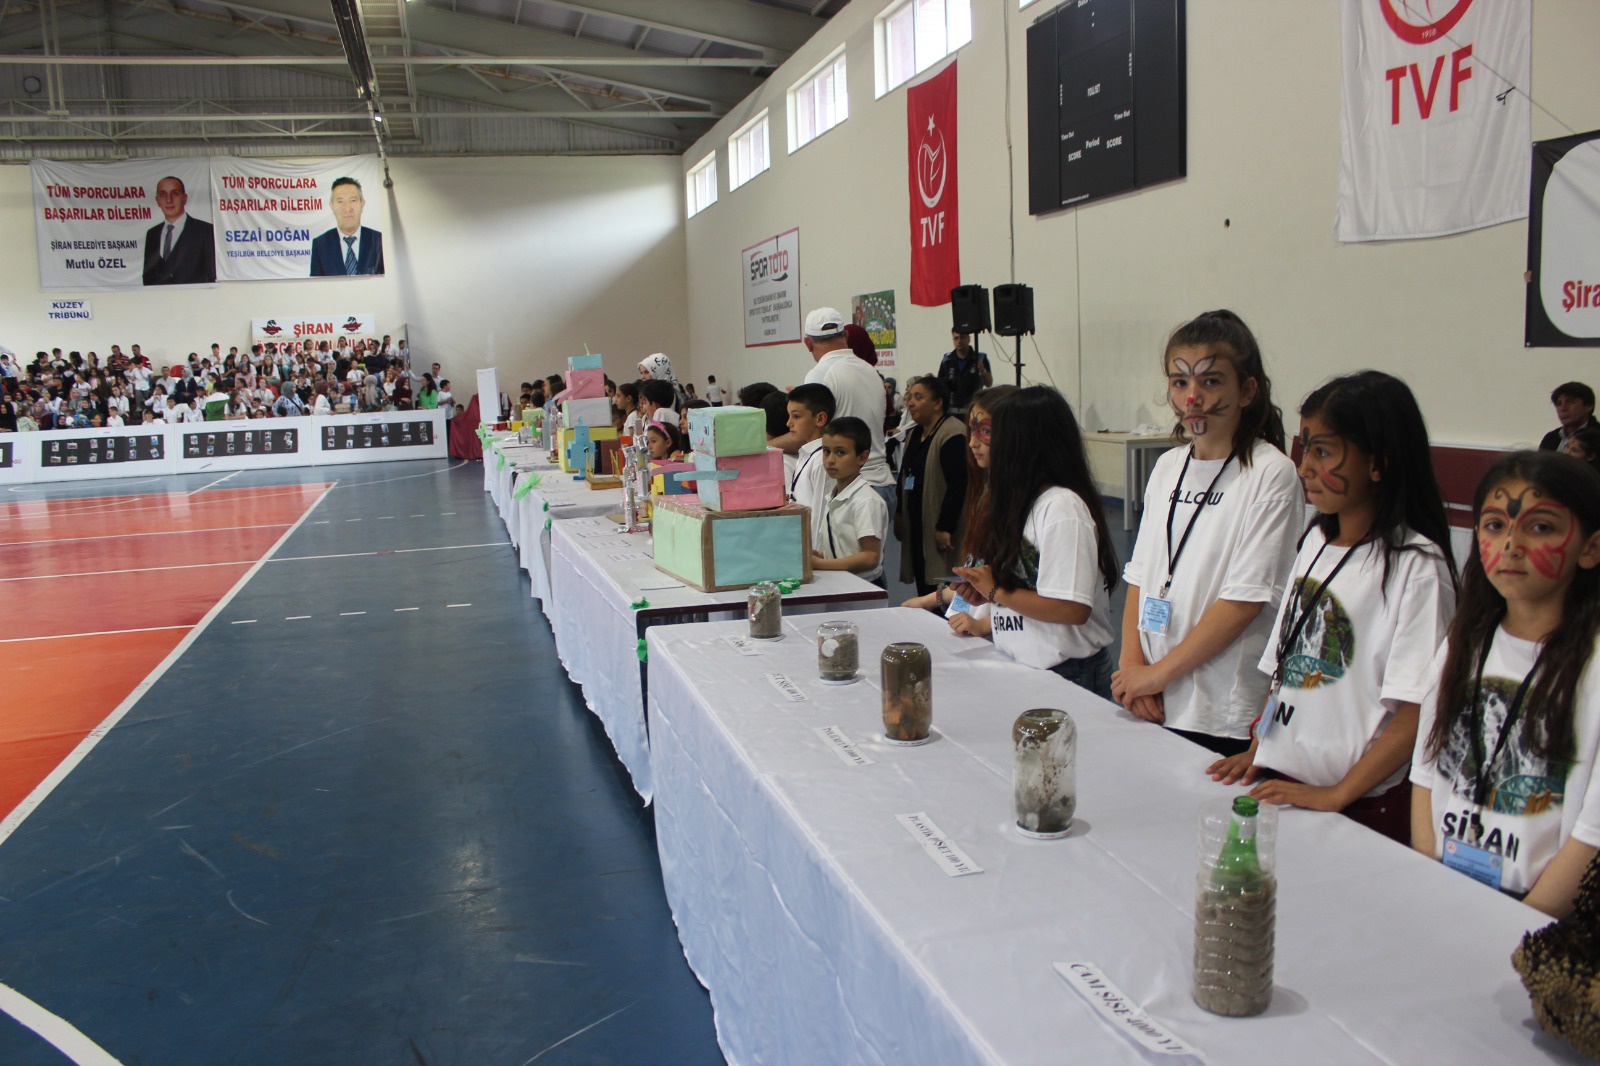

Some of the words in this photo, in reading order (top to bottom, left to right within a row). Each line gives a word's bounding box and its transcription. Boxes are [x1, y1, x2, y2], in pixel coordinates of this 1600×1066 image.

[1385, 43, 1473, 125] TVF
[1086, 136, 1100, 149] Period
[1107, 136, 1122, 149] SCORE
[1068, 150, 1081, 162] SCORE
[222, 174, 245, 189] TÜM
[247, 176, 317, 190] SPORCULARA
[47, 183, 70, 198] TÜM
[73, 186, 146, 200] SPORCULARA
[219, 198, 278, 214] BAŞARILAR
[280, 196, 323, 211] DİLERİM
[44, 207, 105, 223] BAŞARILAR
[108, 204, 152, 221] DİLERİM
[225, 227, 262, 242] SEZAİ
[266, 227, 310, 242] DOĞAN
[920, 211, 944, 248] TVF
[51, 239, 72, 251] ŞİRAN
[73, 239, 106, 249] BELEDİYE
[107, 240, 138, 251] BAŞKANI
[256, 249, 285, 257] BELEDİYE
[285, 248, 311, 258] BAŞKANI
[66, 259, 95, 269] Mutlu
[97, 256, 127, 269] ÖZEL
[751, 257, 768, 280] SPOR
[768, 250, 788, 274] TOTO
[52, 301, 84, 309] KUZEY
[48, 310, 90, 319] TRİBÜNÜ
[293, 321, 333, 339] ŞİRAN
[993, 611, 1024, 635] ŞİRAN
[1070, 963, 1106, 989] CAM
